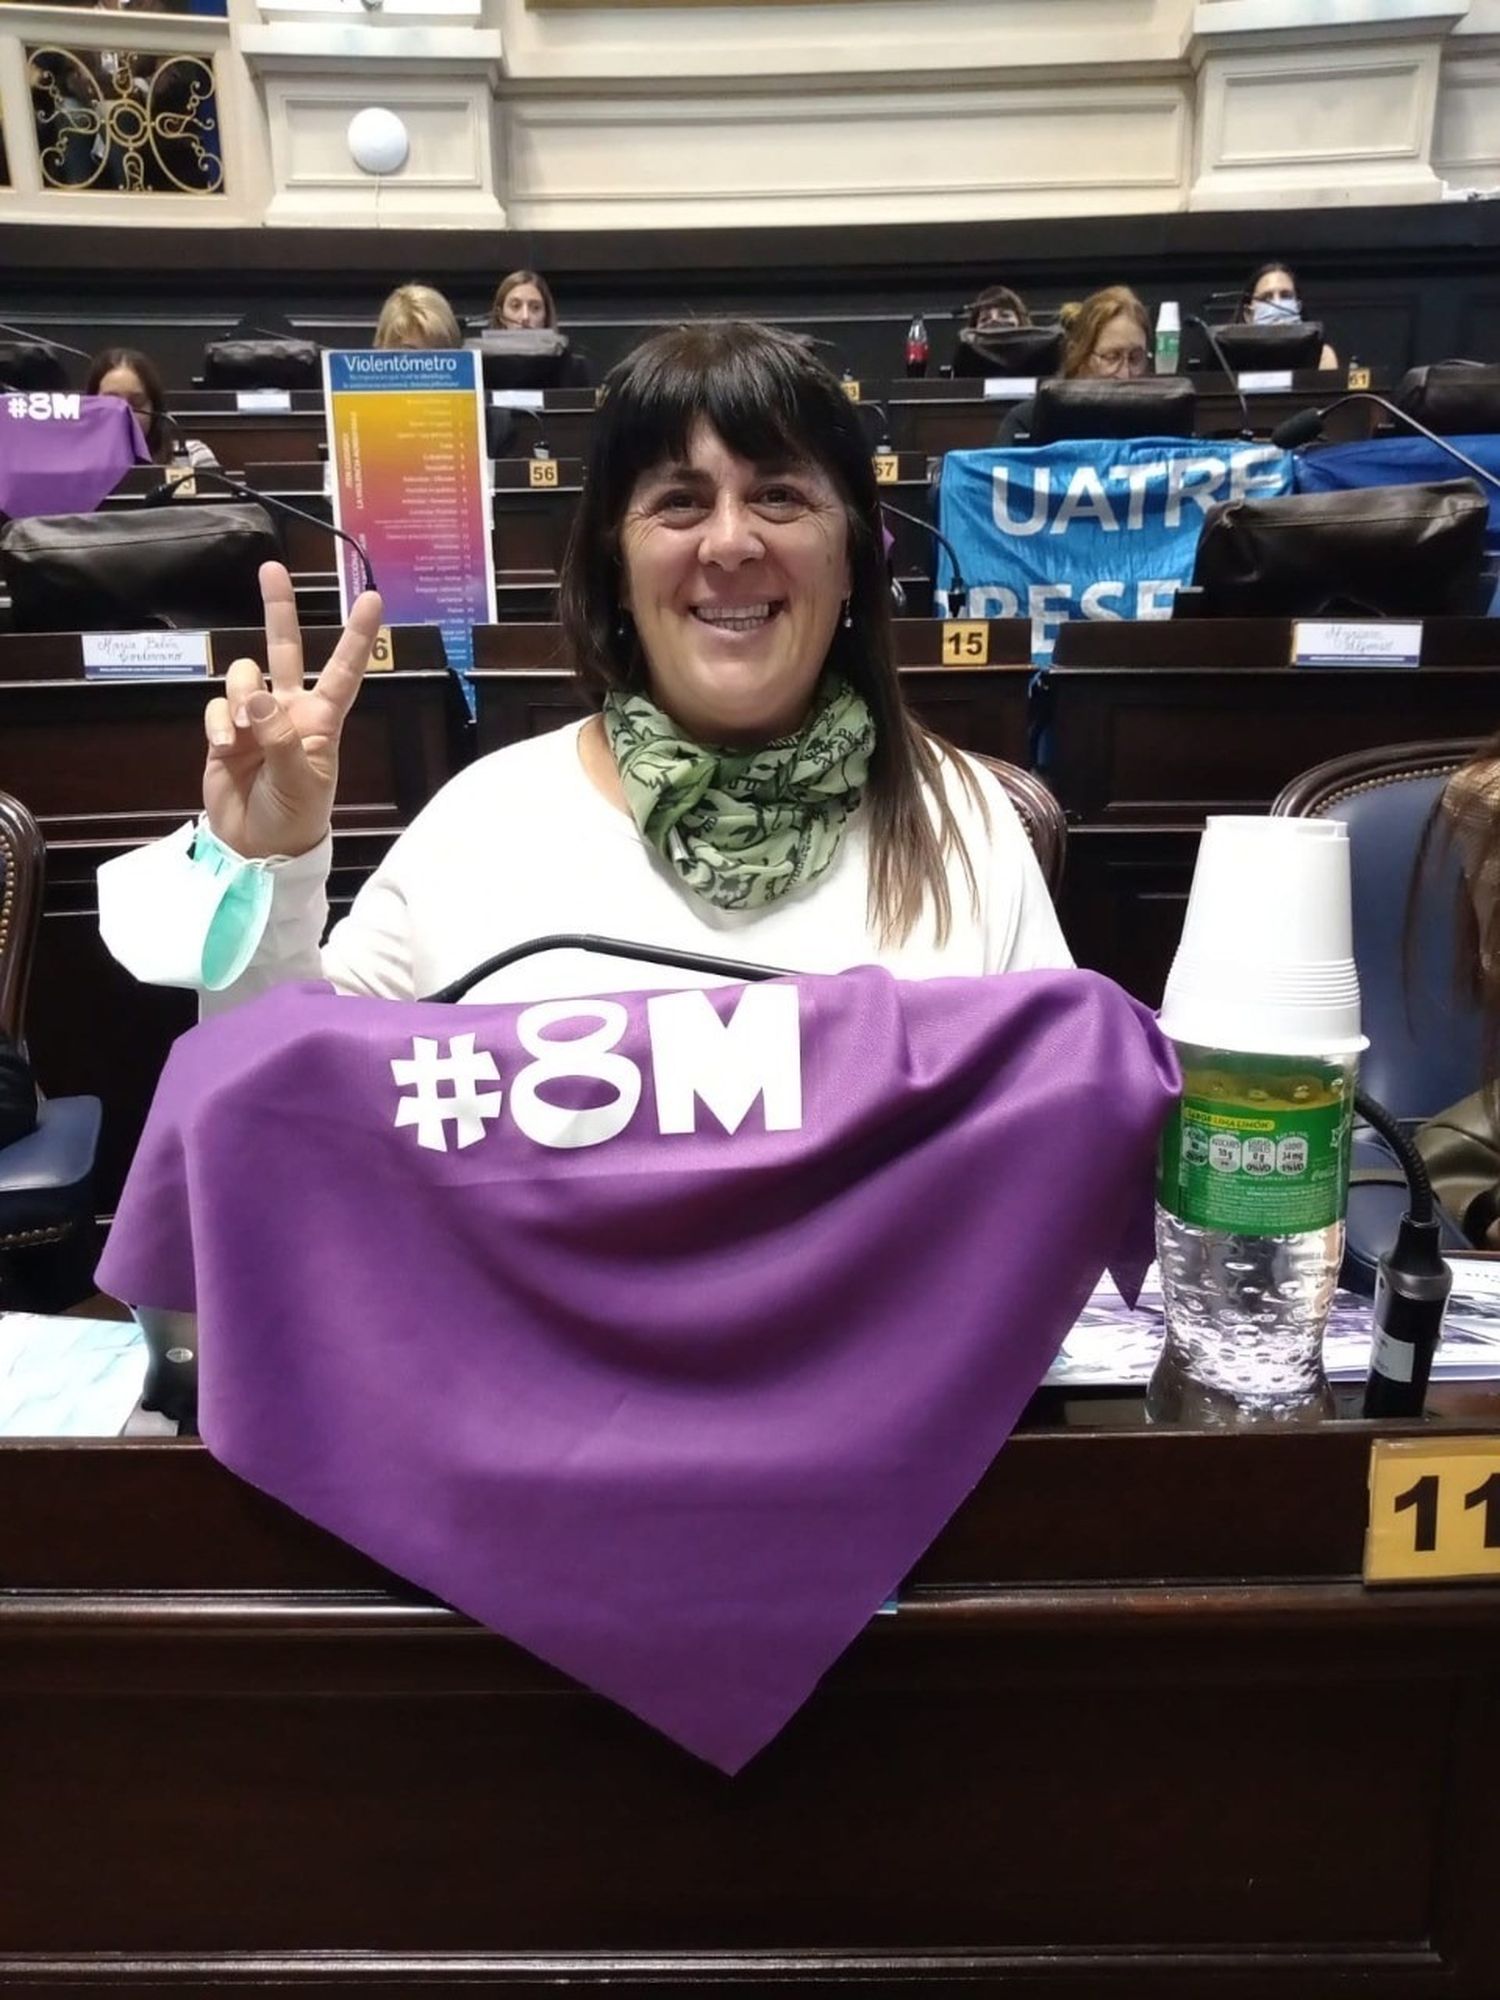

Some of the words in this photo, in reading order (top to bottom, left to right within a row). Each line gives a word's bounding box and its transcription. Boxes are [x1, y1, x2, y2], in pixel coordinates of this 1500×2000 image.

[344, 355, 457, 372] Violentómetro
[8, 392, 80, 420] #8M
[533, 466, 555, 481] 56
[992, 446, 1283, 536] UATRE
[948, 631, 983, 655] 15
[390, 983, 802, 1152] #8M
[1394, 1472, 1500, 1552] 11
